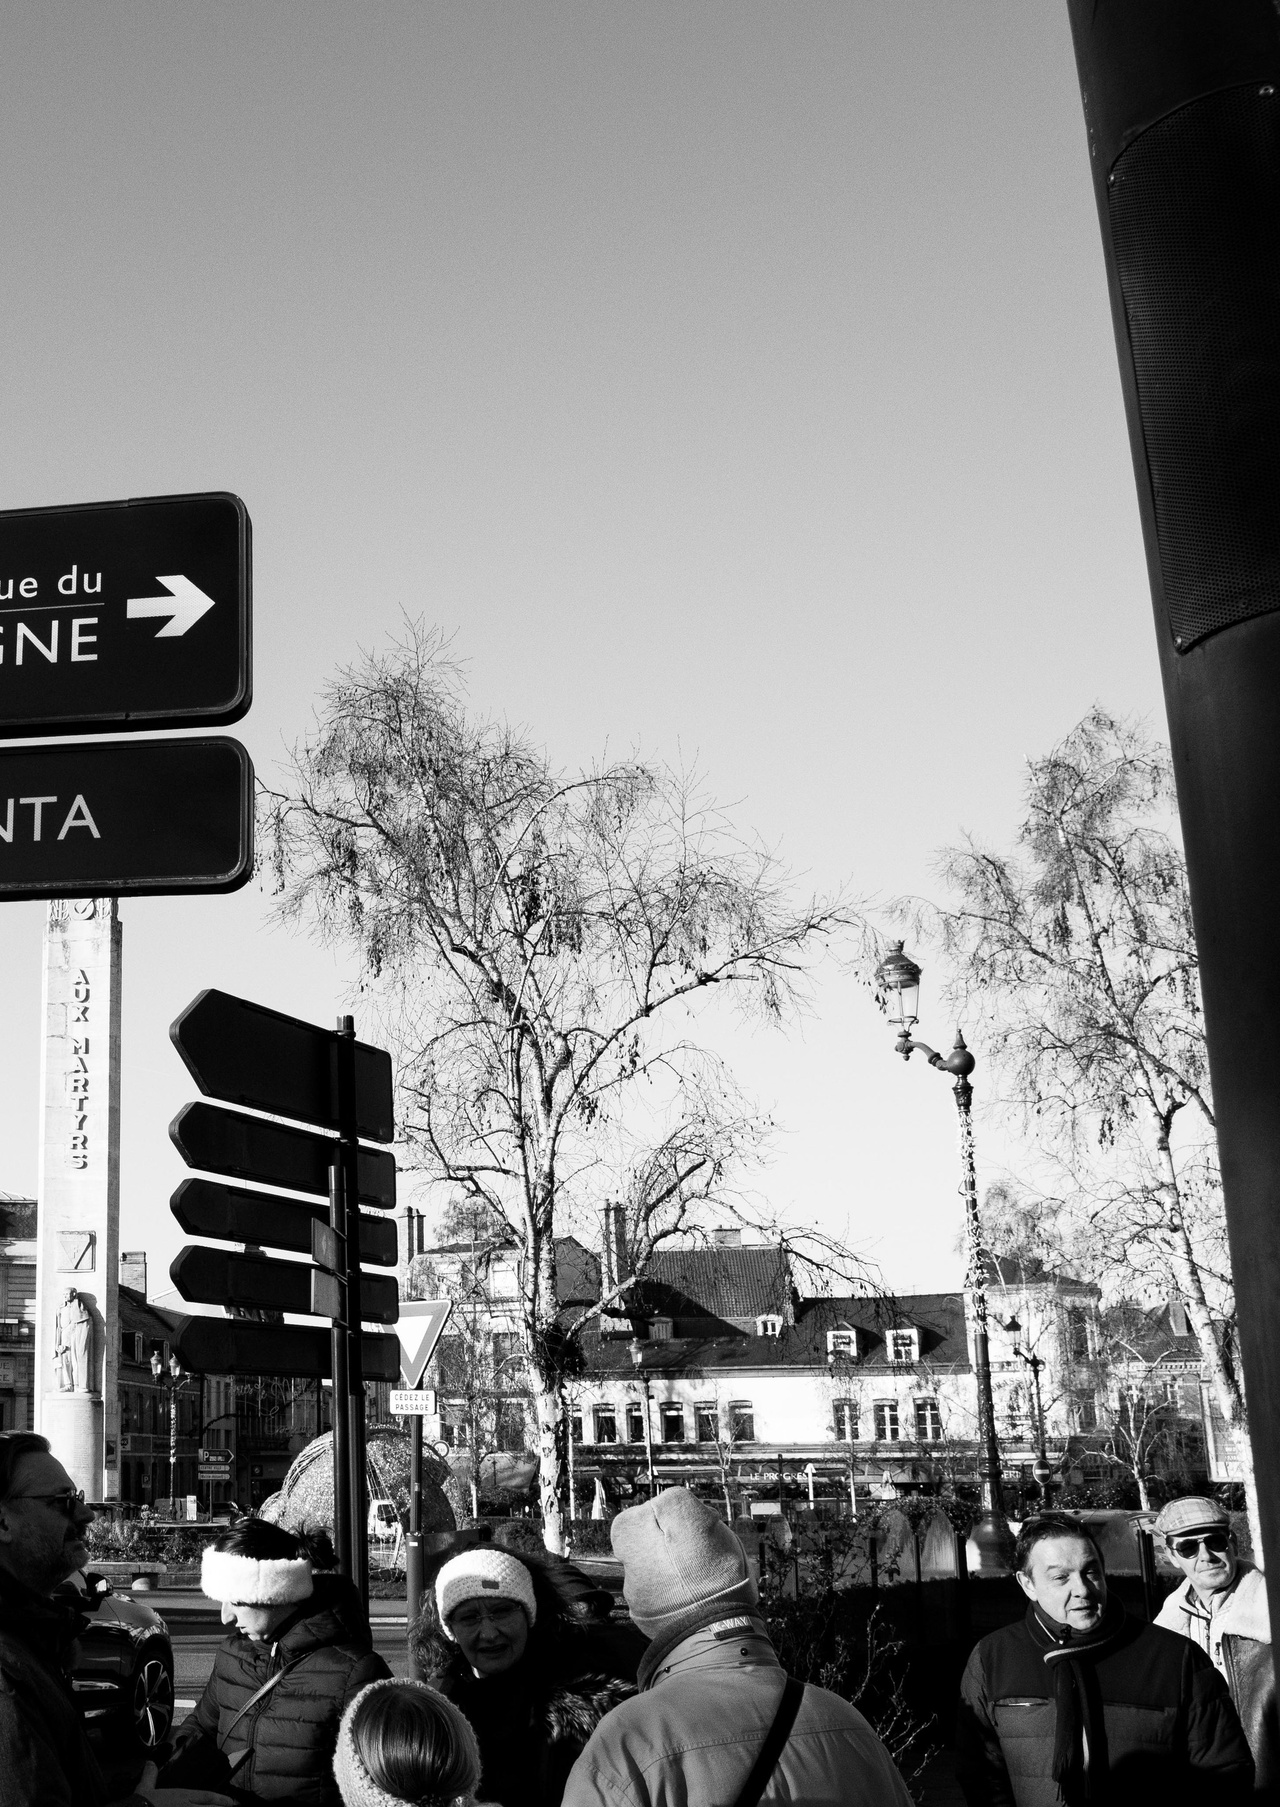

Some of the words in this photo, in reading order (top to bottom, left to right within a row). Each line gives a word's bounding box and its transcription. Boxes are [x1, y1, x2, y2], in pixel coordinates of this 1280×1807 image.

[58, 564, 102, 595] du
[71, 969, 91, 1022] AUX
[70, 1037, 90, 1170] MARTYRS
[394, 1392, 419, 1401] CÉDEZ
[421, 1393, 430, 1401] LE
[395, 1403, 429, 1411] PASSAGE
[750, 1472, 760, 1481] LE
[713, 1616, 748, 1632] K-WAY
